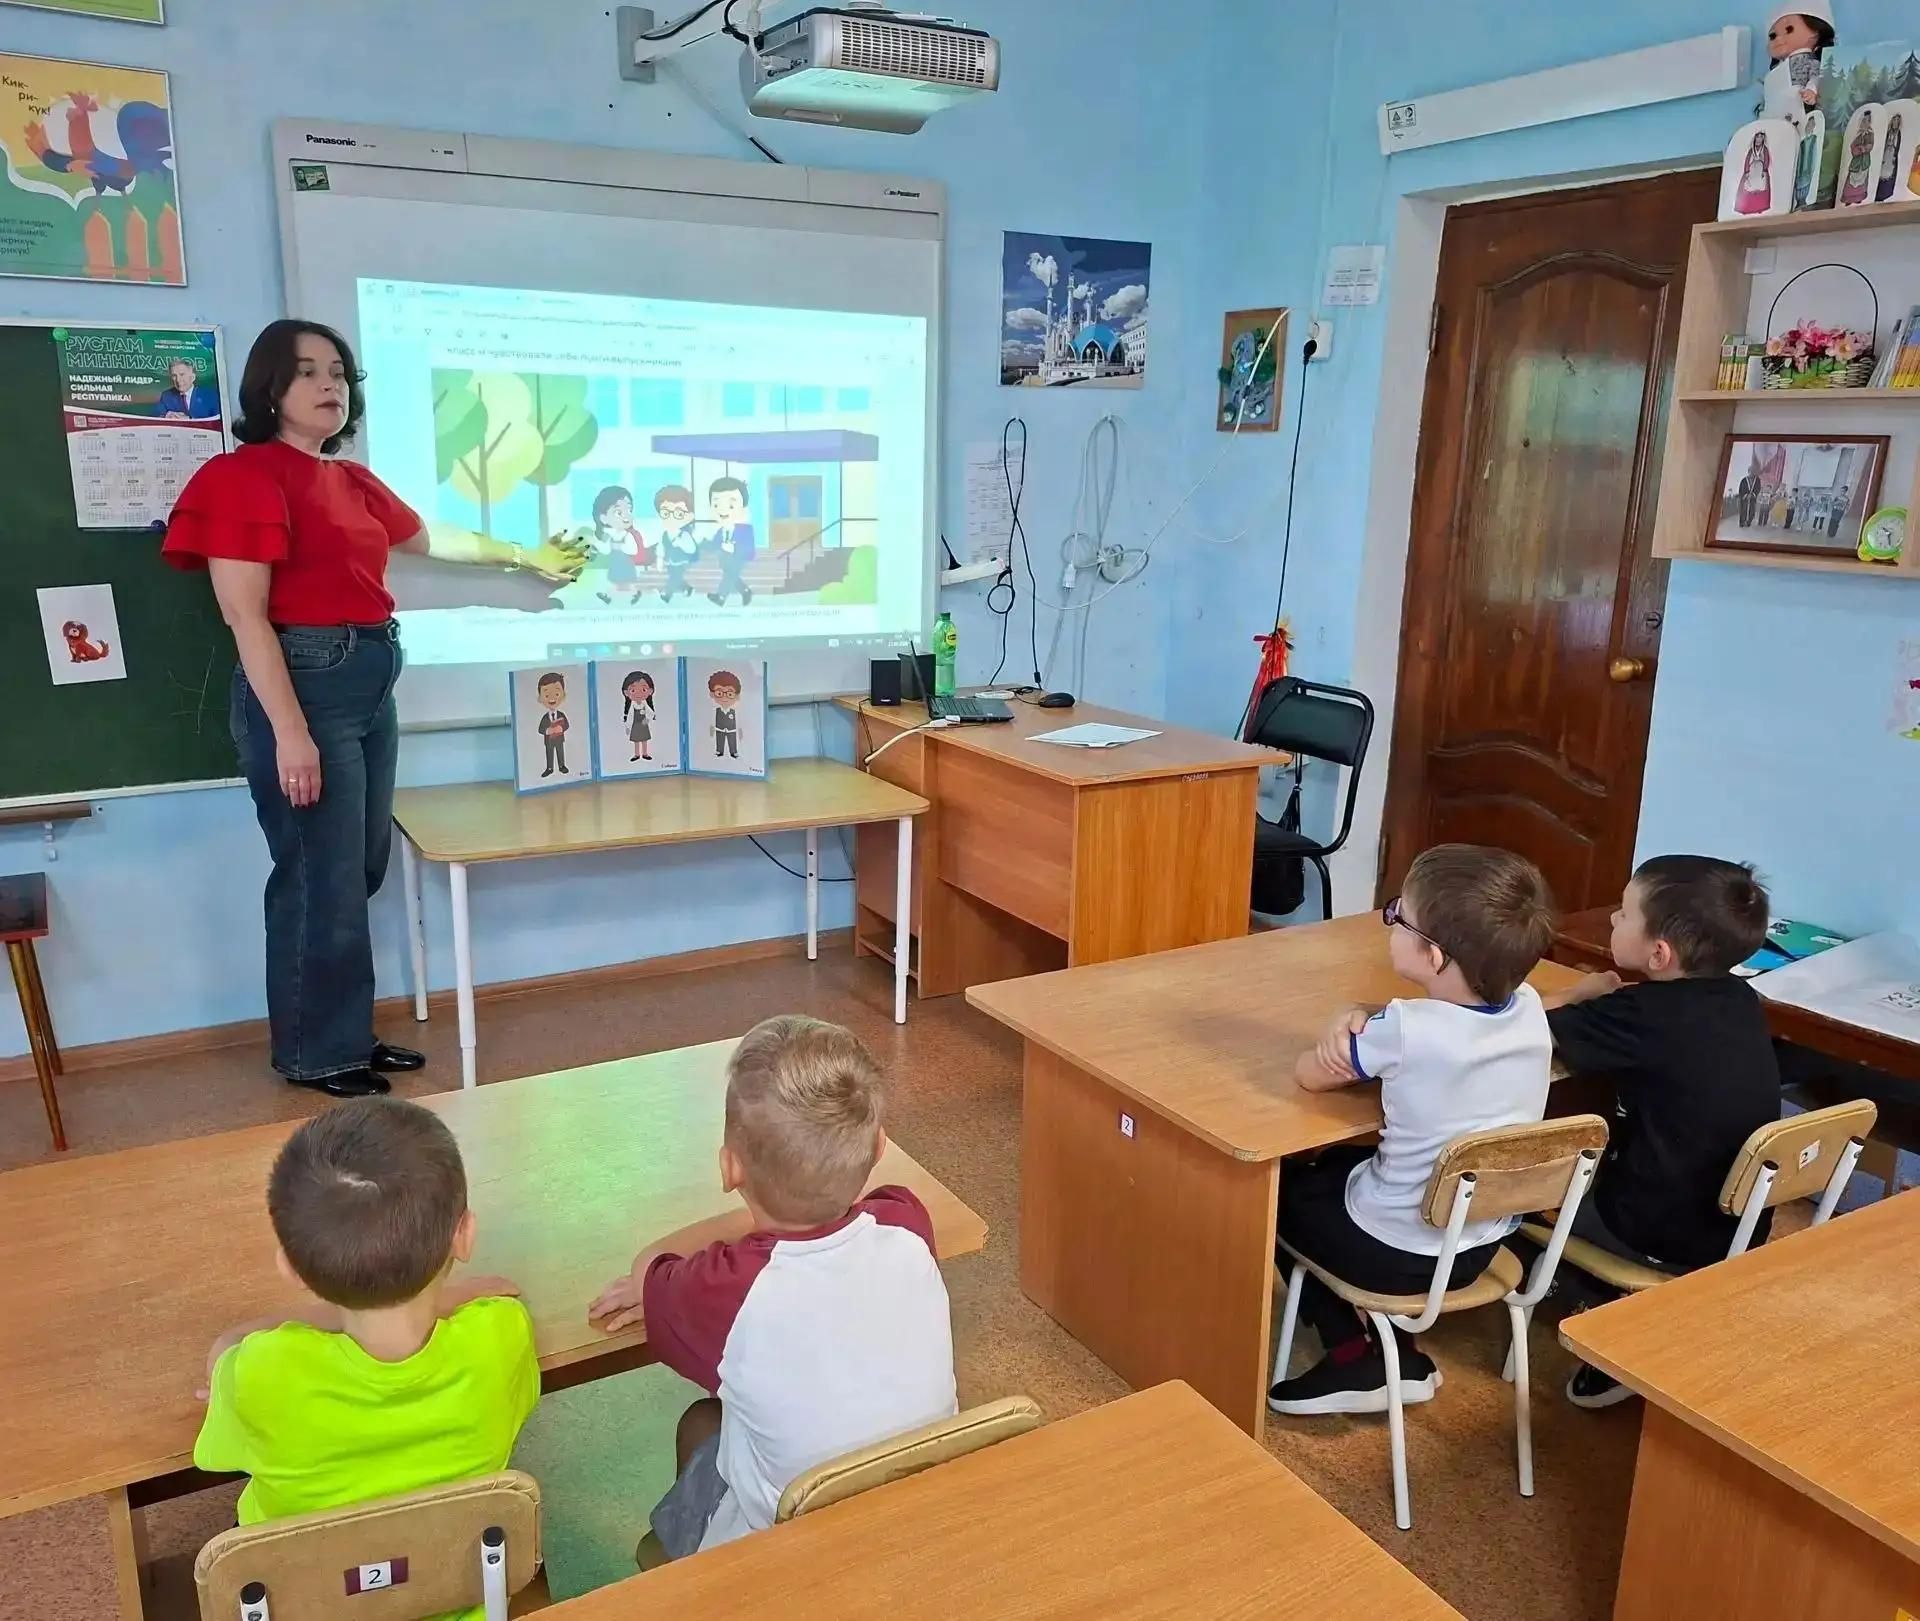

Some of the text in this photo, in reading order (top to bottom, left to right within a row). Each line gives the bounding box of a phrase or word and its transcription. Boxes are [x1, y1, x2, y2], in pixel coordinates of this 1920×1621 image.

[306, 134, 356, 147] Panasonic
[65, 335, 143, 354] РУСТАМ
[69, 374, 123, 384] НАДЕЖНЫЙ
[124, 376, 154, 385] ЛИДЕР
[70, 384, 113, 392] СИЛЬНАЯ
[71, 392, 132, 402] РЕСПУБЛИКА!
[368, 1568, 383, 1585] 2
